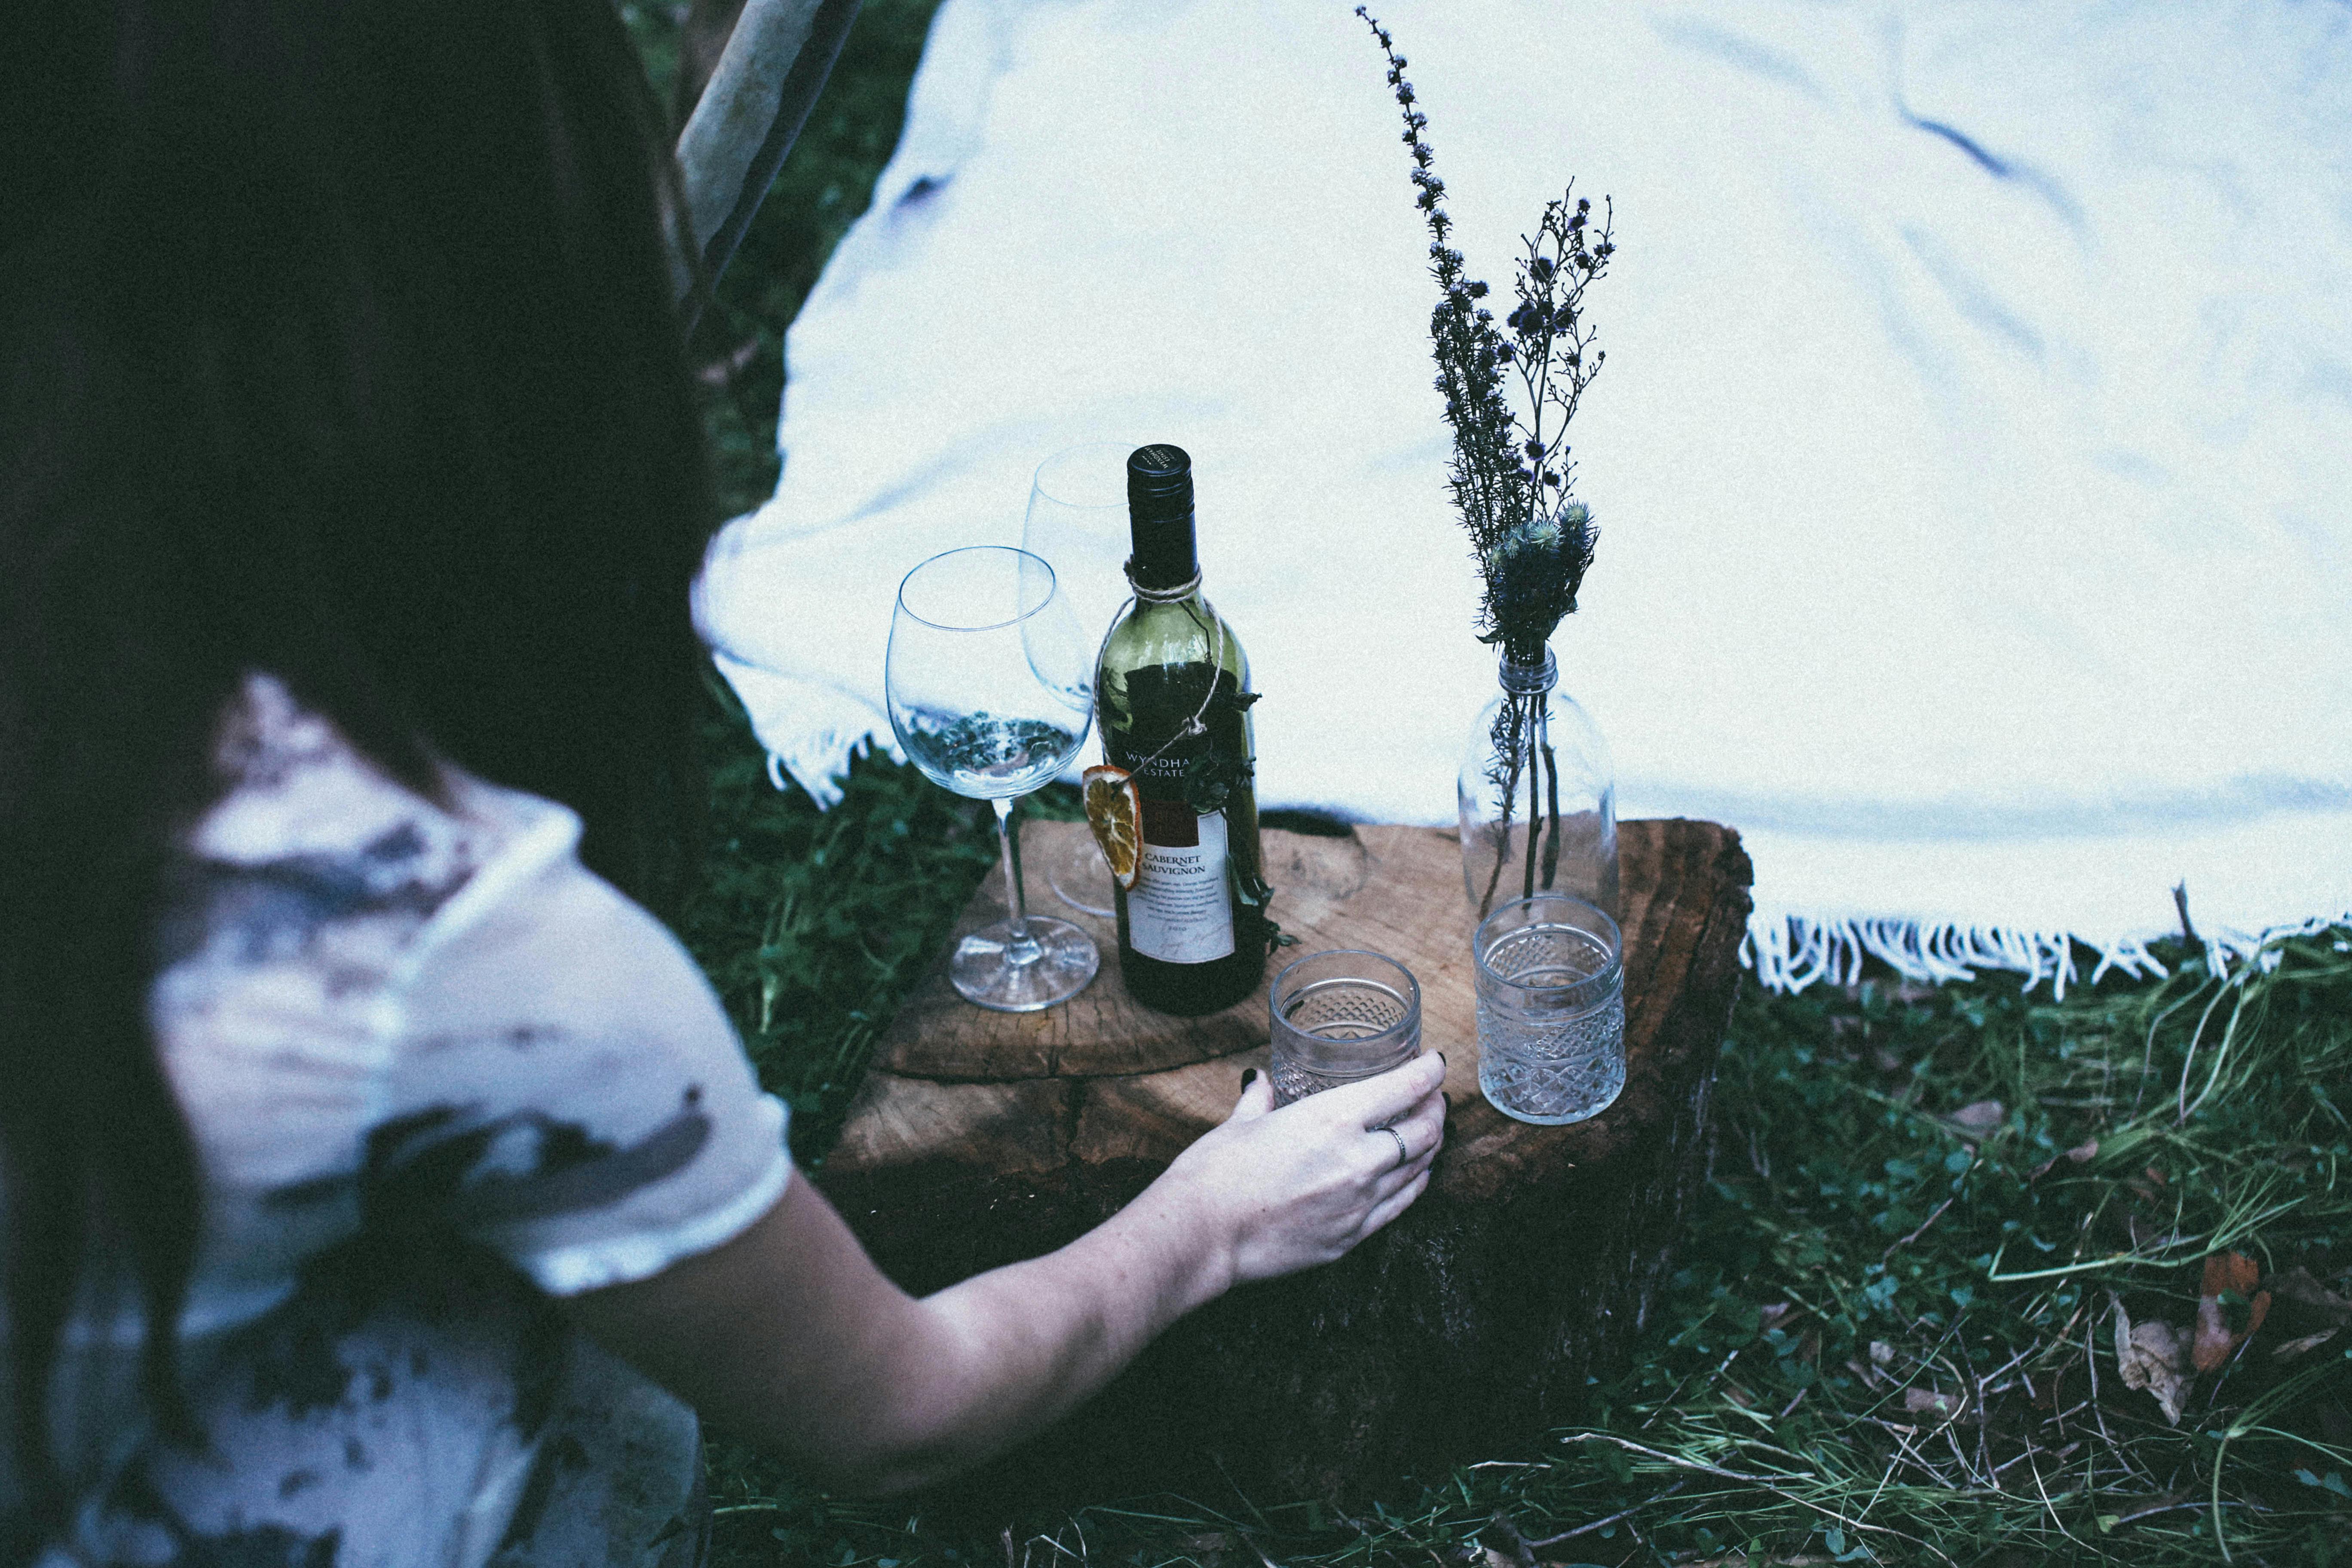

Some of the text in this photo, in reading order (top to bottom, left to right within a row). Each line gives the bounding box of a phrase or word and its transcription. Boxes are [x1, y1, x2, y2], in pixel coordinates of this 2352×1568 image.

[1126, 751, 1189, 768] WYNDHA
[1144, 768, 1185, 777] ESTATE
[1145, 853, 1200, 867] CABERNET
[1142, 863, 1205, 875] SAUVIGNON
